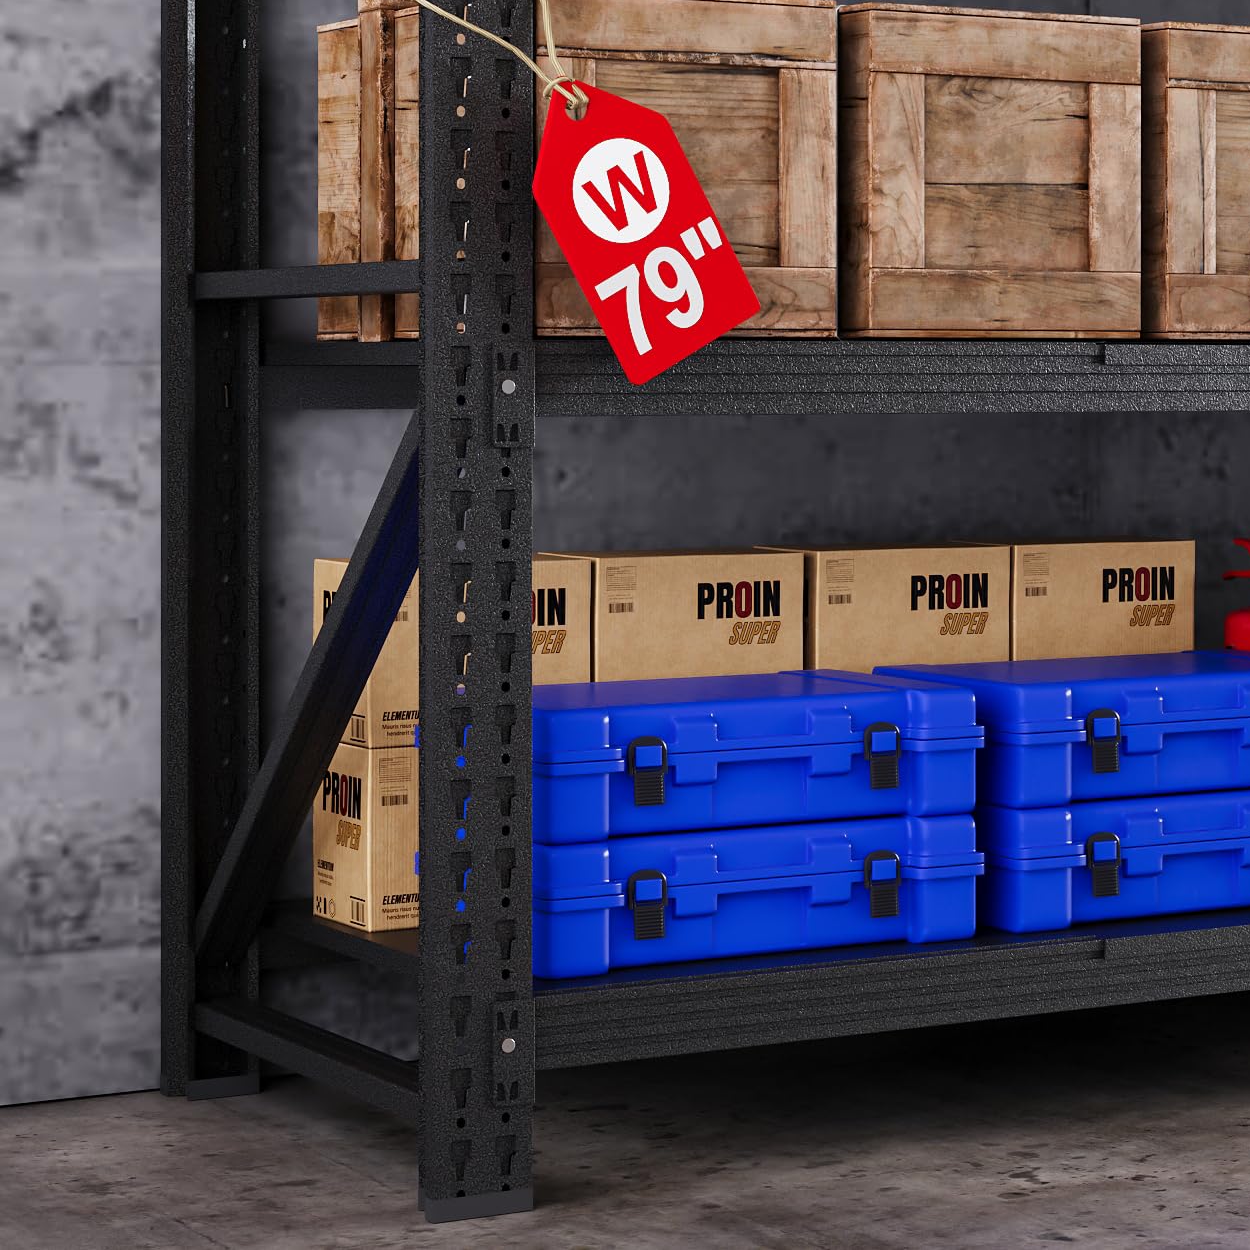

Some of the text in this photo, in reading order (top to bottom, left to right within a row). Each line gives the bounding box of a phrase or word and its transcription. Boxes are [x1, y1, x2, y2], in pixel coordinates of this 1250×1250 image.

[581, 150, 657, 231] W
[594, 216, 723, 356] 79"
[697, 580, 781, 619] PROIN
[910, 573, 988, 611] PROIN
[1102, 566, 1175, 603] PROIN
[940, 612, 989, 636] SUPER
[1130, 604, 1175, 626] SUPER
[729, 621, 781, 645] SUPER
[382, 711, 419, 721] ELEMENTU
[322, 770, 362, 820] PROIN
[336, 819, 361, 851] SUPER
[382, 893, 419, 905] ELEMENTU
